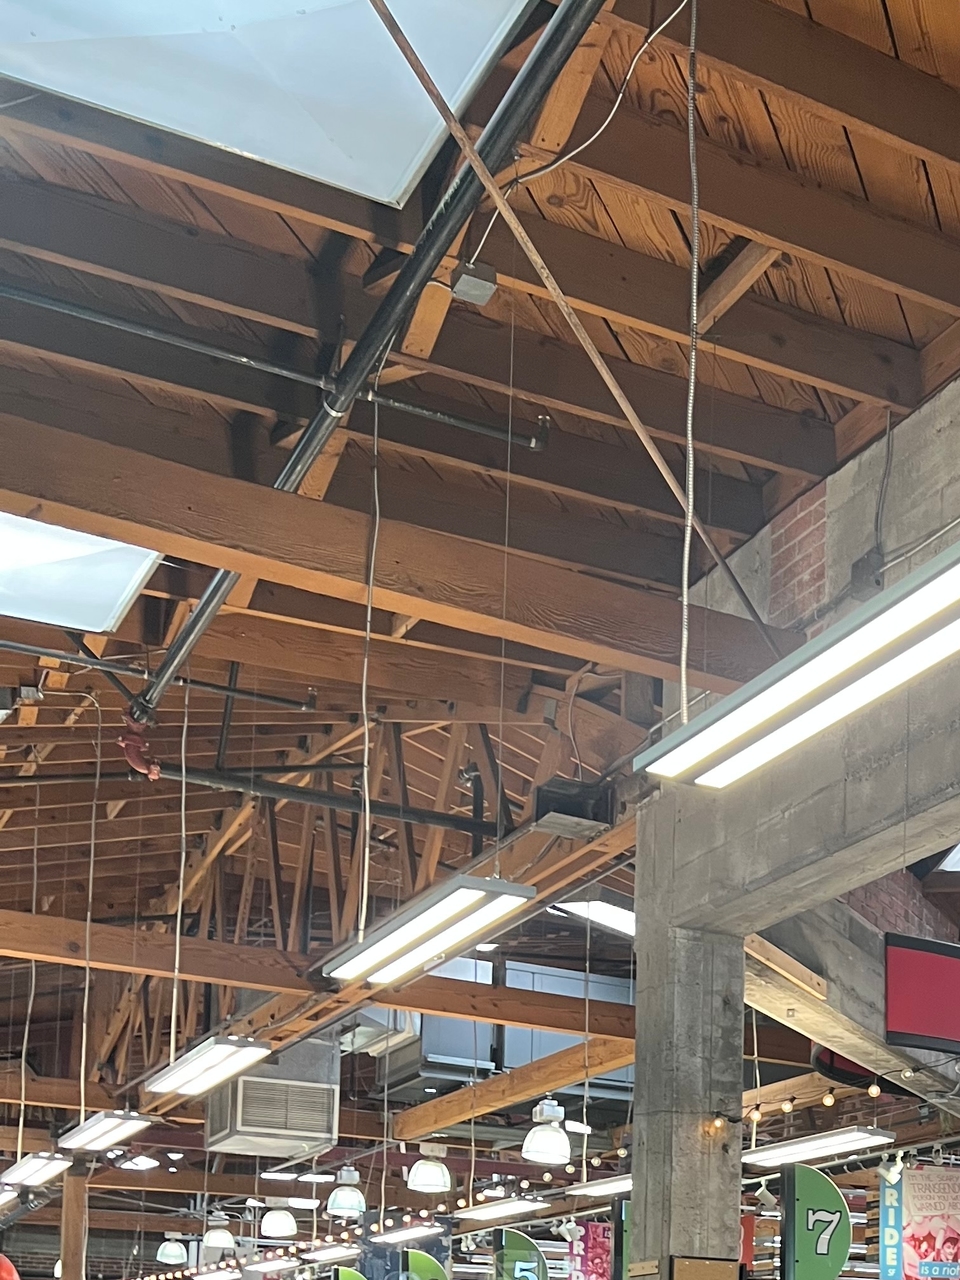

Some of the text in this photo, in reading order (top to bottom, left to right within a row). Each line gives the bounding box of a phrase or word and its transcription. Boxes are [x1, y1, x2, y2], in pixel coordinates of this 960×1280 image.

[807, 1208, 842, 1256] 7
[884, 1180, 899, 1266] RIDE
[921, 1262, 960, 1276] is a riot
